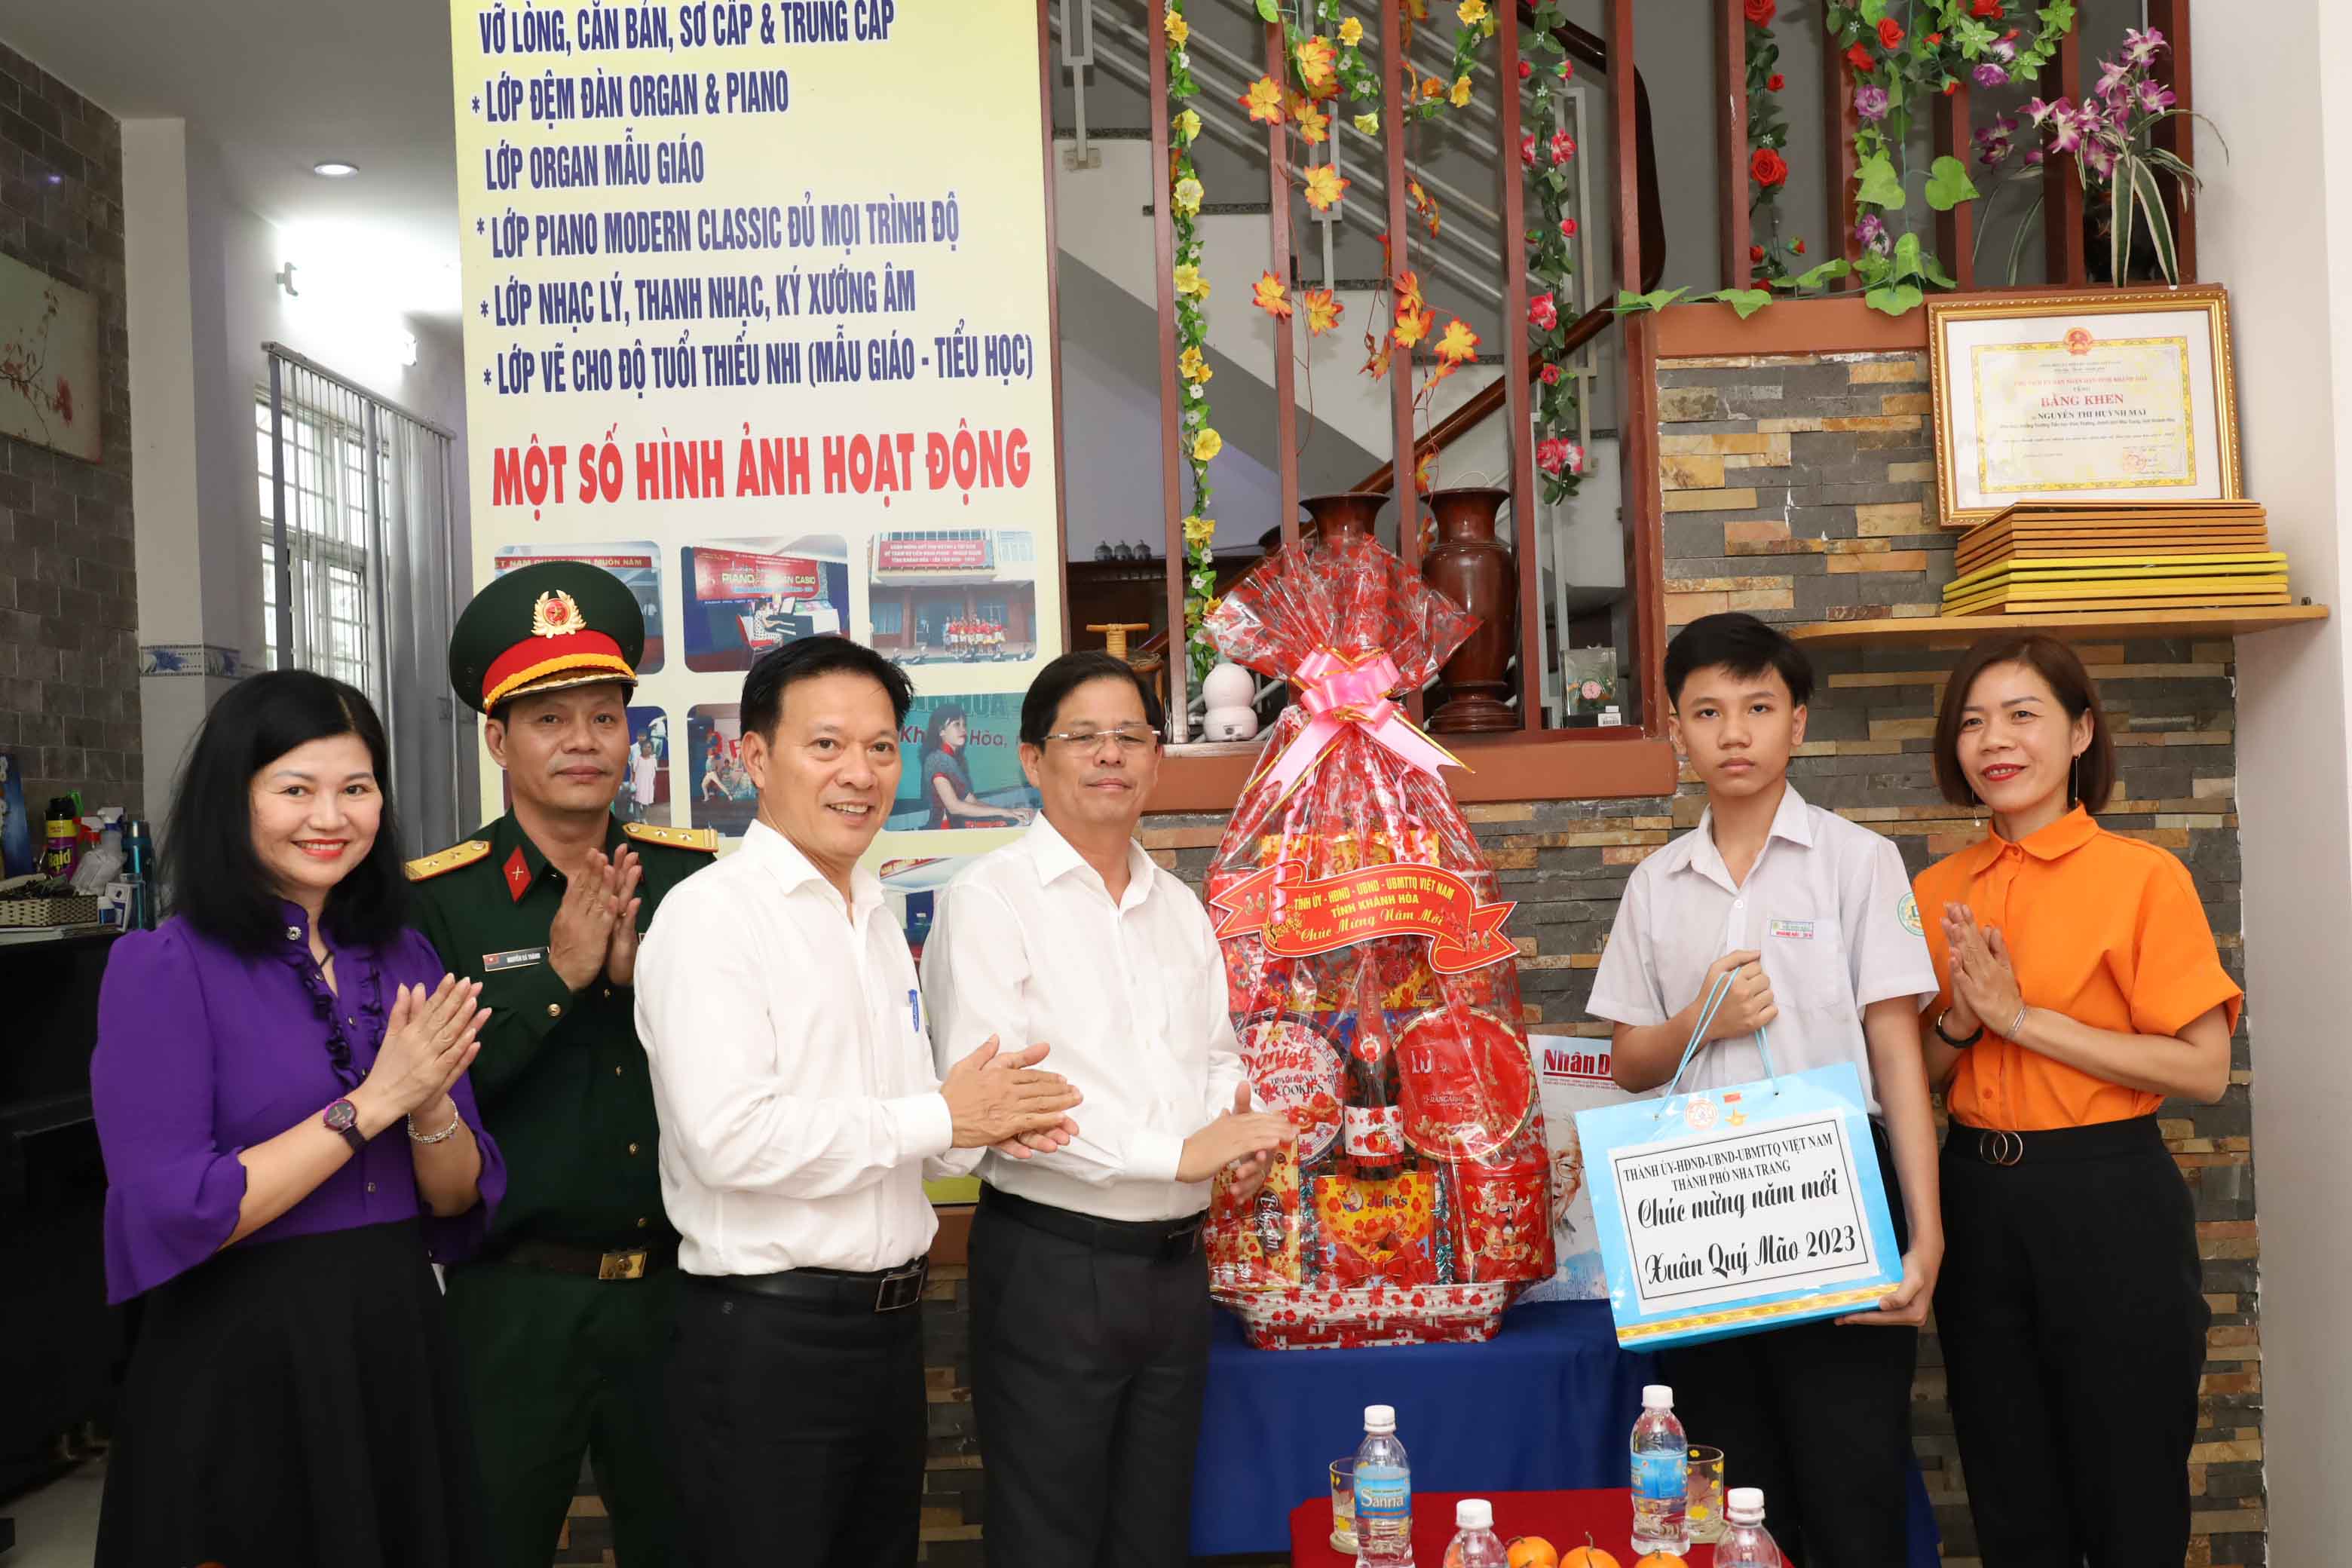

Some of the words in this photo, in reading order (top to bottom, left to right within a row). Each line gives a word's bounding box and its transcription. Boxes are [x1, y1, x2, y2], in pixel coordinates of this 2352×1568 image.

[480, 3, 505, 54] VỠ
[513, 0, 571, 56] LÒNG,
[578, 0, 619, 51] CĂN
[680, 2, 706, 47] SƠ
[761, 3, 775, 44] &
[781, 0, 848, 42] TRUNG
[486, 72, 523, 121] LỚP
[531, 70, 574, 127] ĐỆM
[581, 69, 623, 118] ĐÀN
[630, 74, 698, 117] ORGAN
[706, 73, 719, 115] &
[727, 70, 788, 112] PIANO
[486, 143, 522, 190] LỚP
[531, 145, 598, 188] ORGAN
[605, 128, 650, 185] MẪU
[657, 133, 703, 183] GIÁO
[492, 209, 528, 258] LỚP
[536, 213, 597, 254] PIANO
[605, 210, 691, 253] MODERN
[699, 207, 781, 250] CLASSIC
[789, 192, 814, 247] ĐỦ
[822, 205, 859, 256] MỌI
[866, 194, 926, 242] TRÌNH
[933, 191, 958, 251] ĐỘ
[495, 276, 531, 326] LỚP
[539, 281, 594, 333] NHẠC
[601, 274, 629, 325] LÝ,
[635, 278, 702, 320] THANH
[709, 275, 770, 327] NHẠC,
[776, 268, 801, 314] KÝ
[809, 265, 877, 314] XƯỚNG
[884, 262, 915, 312] ÂM
[498, 345, 534, 394] LỚP
[542, 343, 566, 392] VẼ
[573, 350, 612, 391] CHO
[619, 338, 645, 398] ĐỘ
[651, 329, 697, 387] TUỔI
[703, 330, 759, 386] THIẾU
[766, 342, 801, 384] NHI
[809, 324, 861, 386] (MẪU
[868, 330, 914, 381] GIÁO
[936, 320, 978, 378] TIỂU
[986, 334, 1032, 385] HỌC)
[2084, 393, 2124, 405] KHEN
[495, 434, 567, 519] MỘT
[580, 424, 623, 504] SỐ
[637, 427, 724, 501] HÌNH
[737, 422, 810, 497] ẢNH
[824, 434, 914, 506] HOẠT
[926, 418, 1030, 504] ĐỘNG
[1328, 887, 1351, 903] HĐND
[1356, 880, 1380, 896] UBND
[1386, 877, 1418, 890] UBMTTQ
[1419, 875, 1435, 893] VIỆT
[1435, 880, 1456, 900] NAM
[1331, 902, 1356, 918] TỈNH
[1358, 894, 1396, 911] KHÁNH
[1398, 893, 1419, 905] HÒA
[1300, 926, 1332, 942] Chúc
[1338, 914, 1376, 934] Mừng
[1418, 908, 1444, 926] Mới
[1543, 1049, 1595, 1074] Nhân
[1624, 1163, 1659, 1182] THÀNH
[1783, 1138, 1806, 1155] VIỆT
[1808, 1133, 1833, 1148] NAM
[1671, 1174, 1707, 1192] THÀNH
[1732, 1166, 1754, 1182] NHA
[1755, 1159, 1790, 1178] TRANG
[1638, 1197, 1686, 1229] Chúc
[1692, 1190, 1747, 1218] mừng
[1752, 1181, 1796, 1209] năm
[1802, 1168, 1839, 1200] mới
[1645, 1252, 1704, 1284] Xuân
[1708, 1242, 1750, 1279] Quý
[1754, 1234, 1800, 1266] Mão
[1806, 1225, 1855, 1257] 2023
[1361, 1488, 1404, 1508] Sanna
